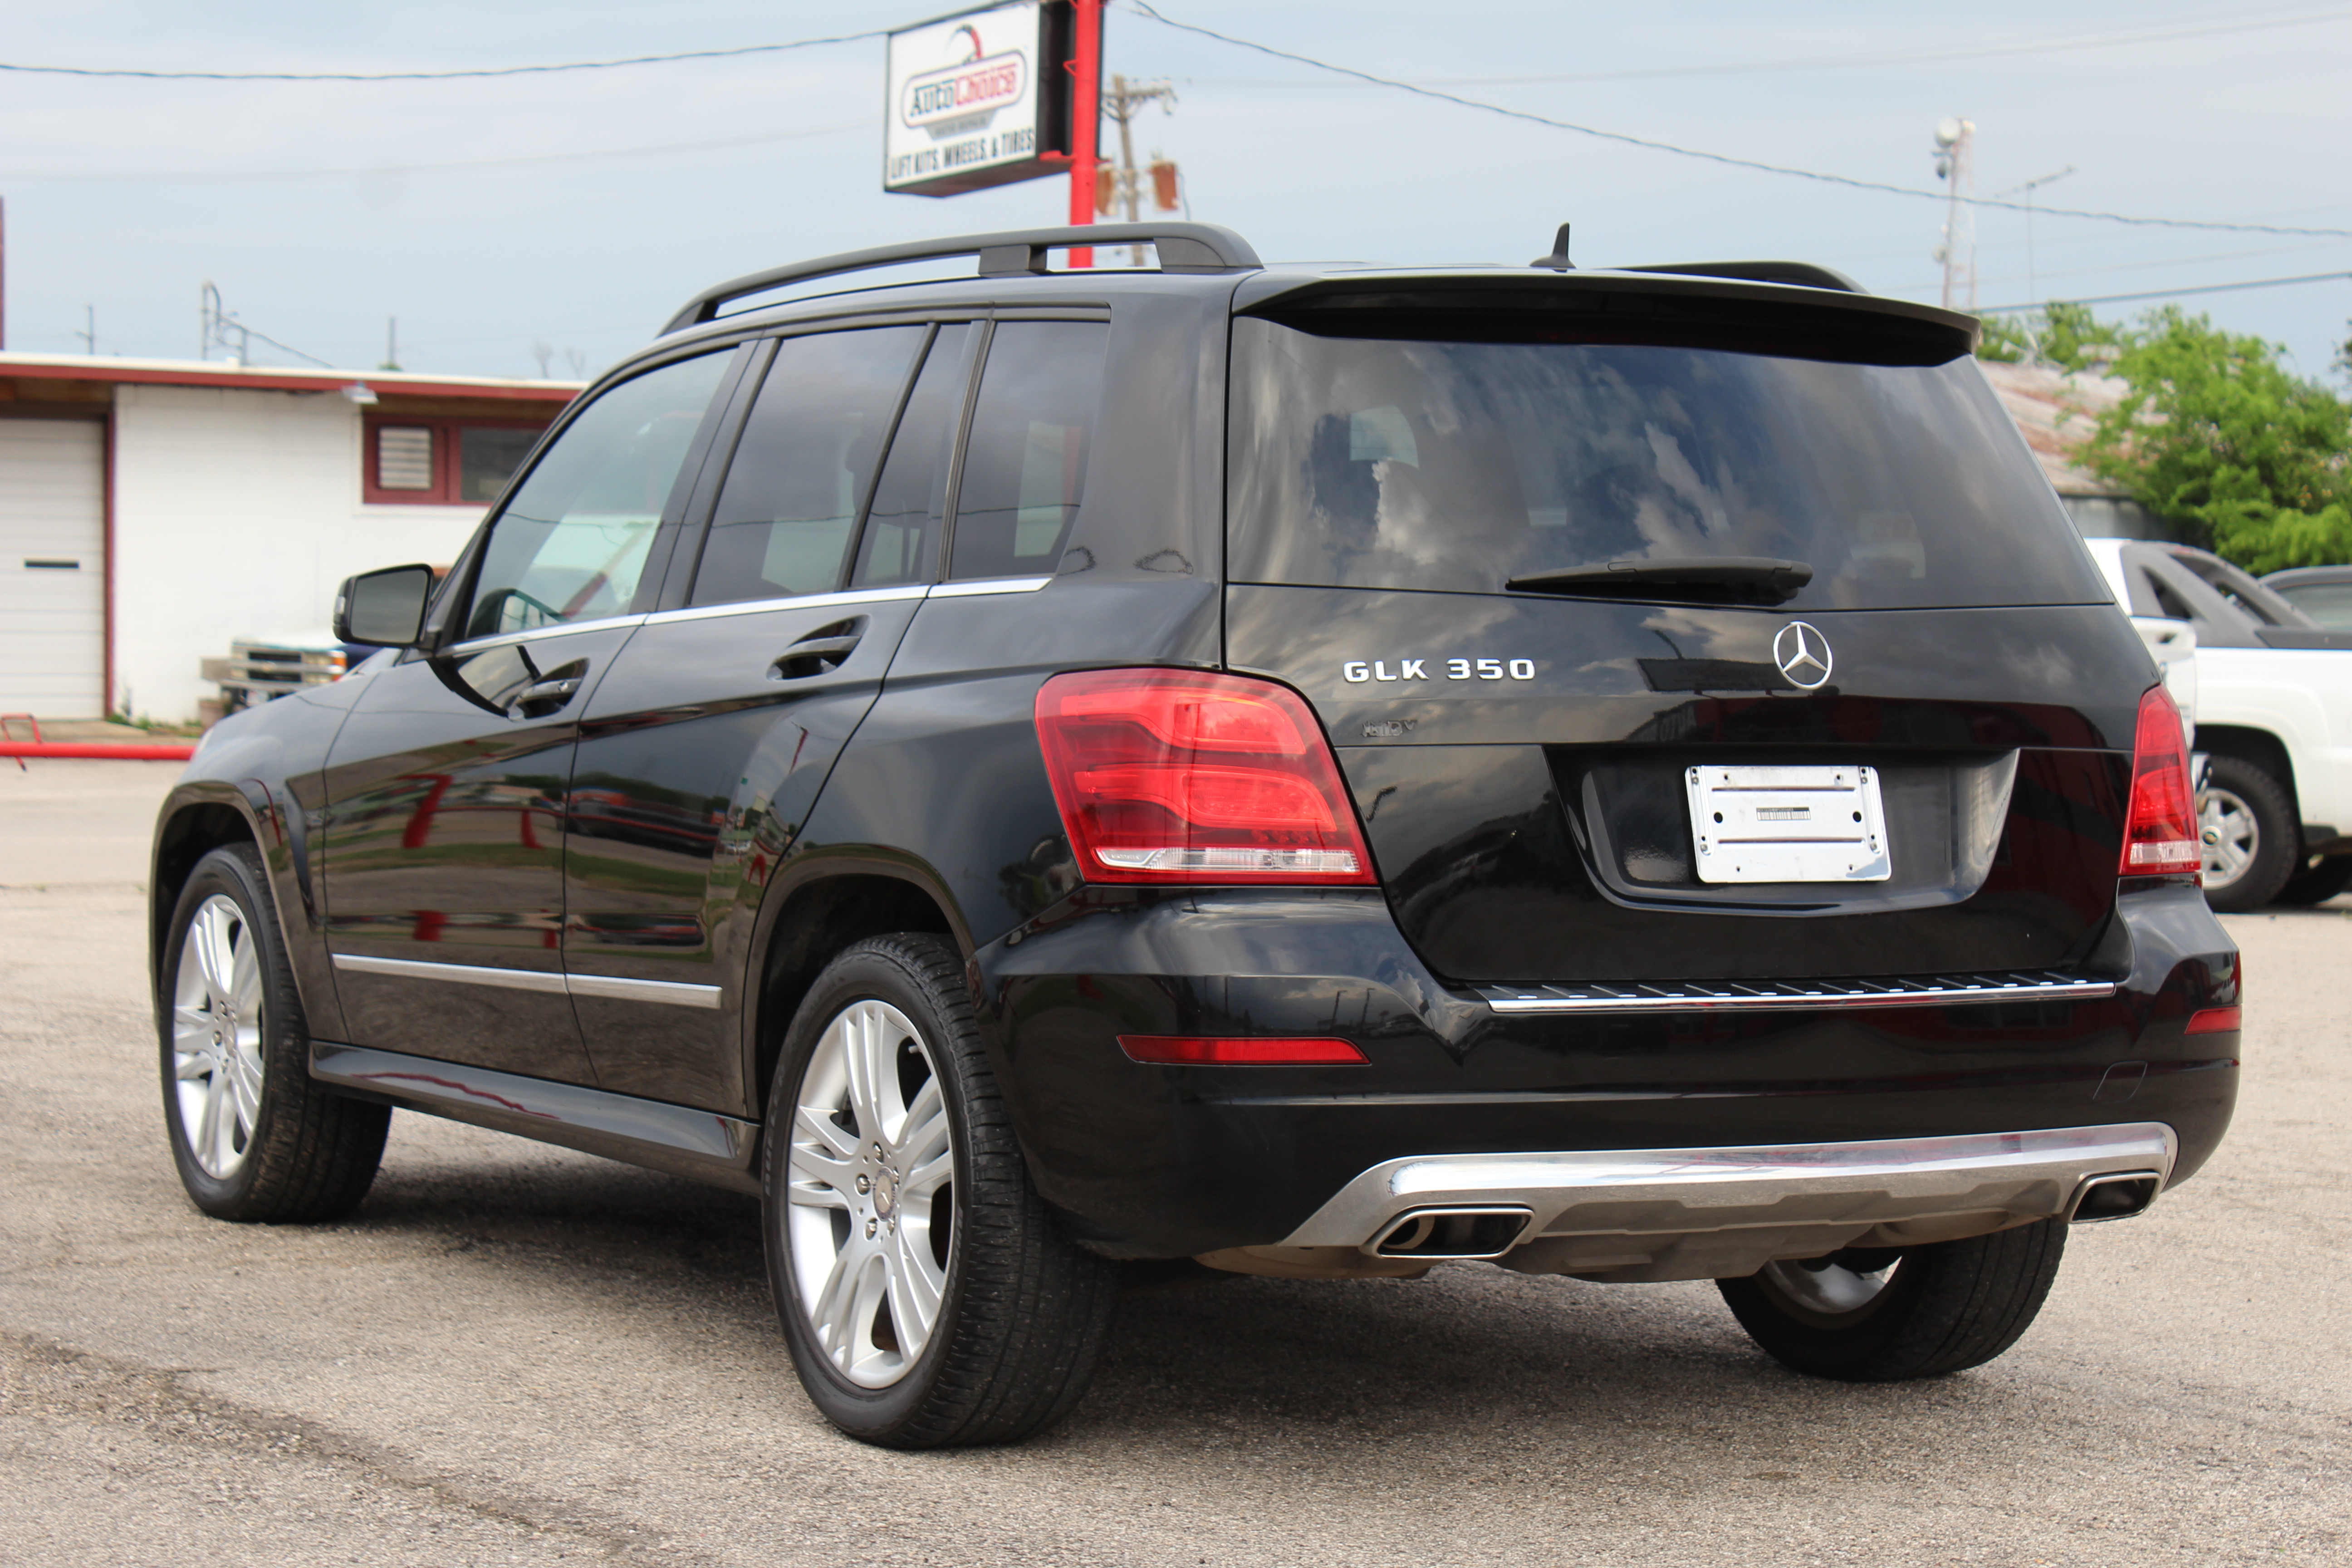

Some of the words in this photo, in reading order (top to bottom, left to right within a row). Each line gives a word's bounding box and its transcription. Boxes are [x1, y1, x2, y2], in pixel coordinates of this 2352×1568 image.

[891, 154, 911, 179] LIFT
[1002, 127, 1035, 156] TIRES
[1343, 659, 1429, 682] GLK
[1446, 658, 1536, 681] 350
